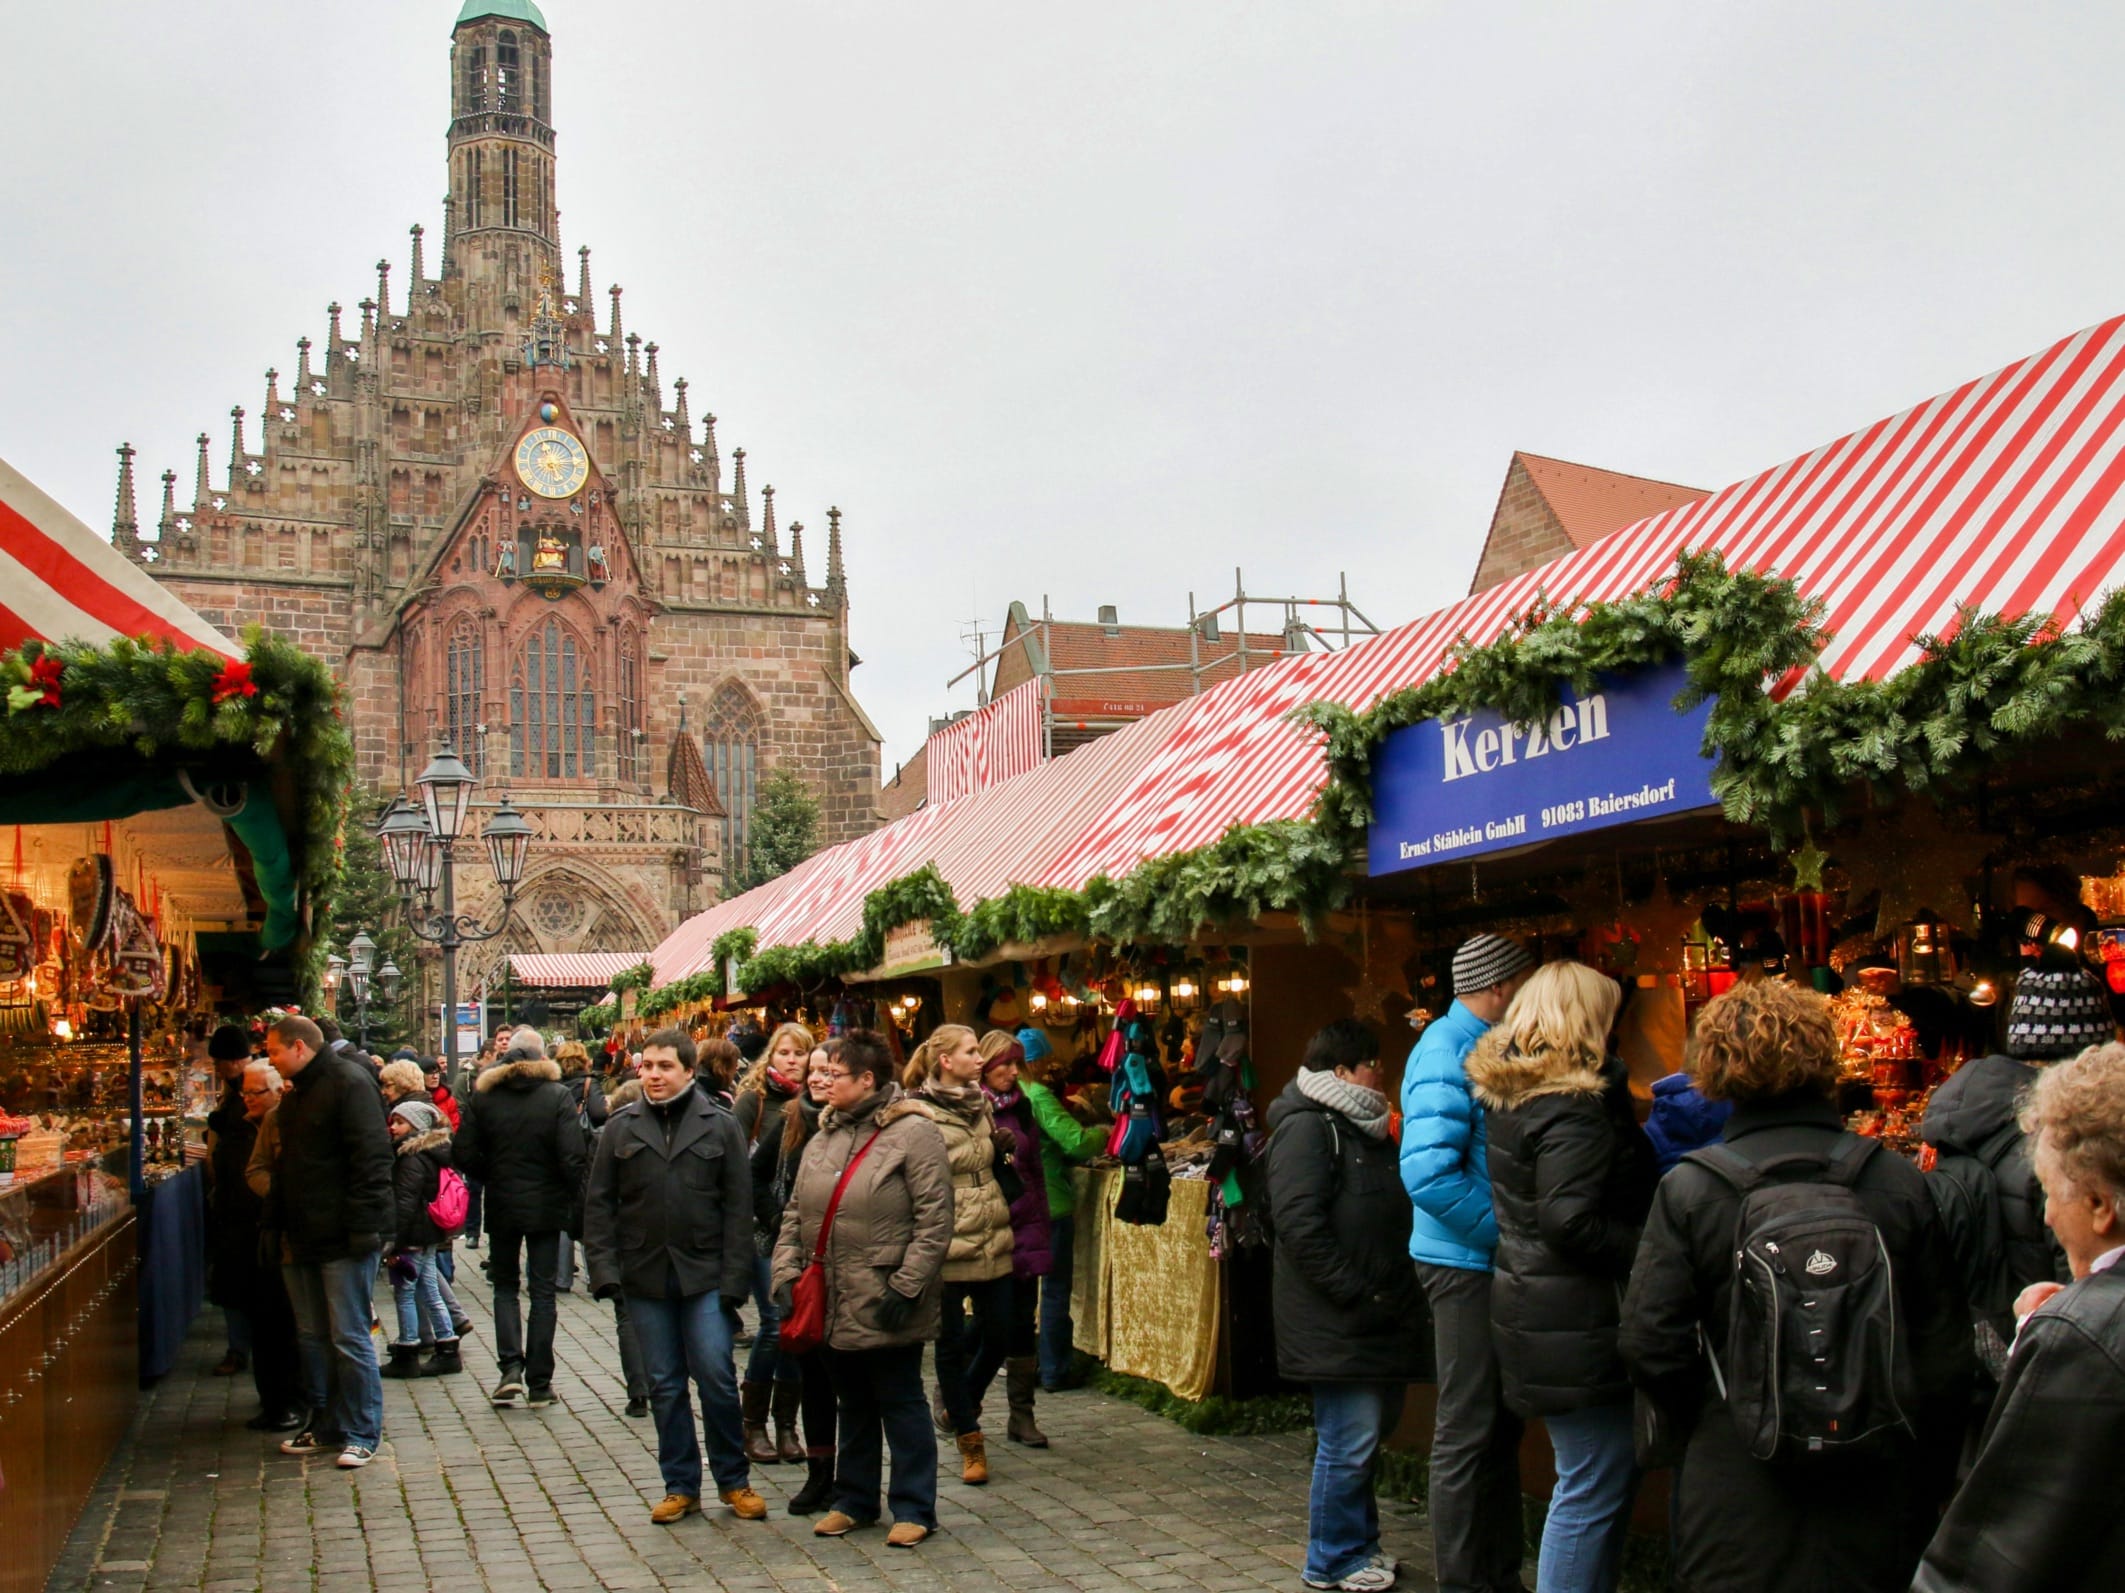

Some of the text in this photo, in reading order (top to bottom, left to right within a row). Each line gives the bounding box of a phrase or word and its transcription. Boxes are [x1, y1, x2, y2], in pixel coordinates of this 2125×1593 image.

[1440, 694, 1610, 783] Kerzen
[1399, 778, 1676, 860] Ernst Stäblein GmbH 91083 Baiersdorf
